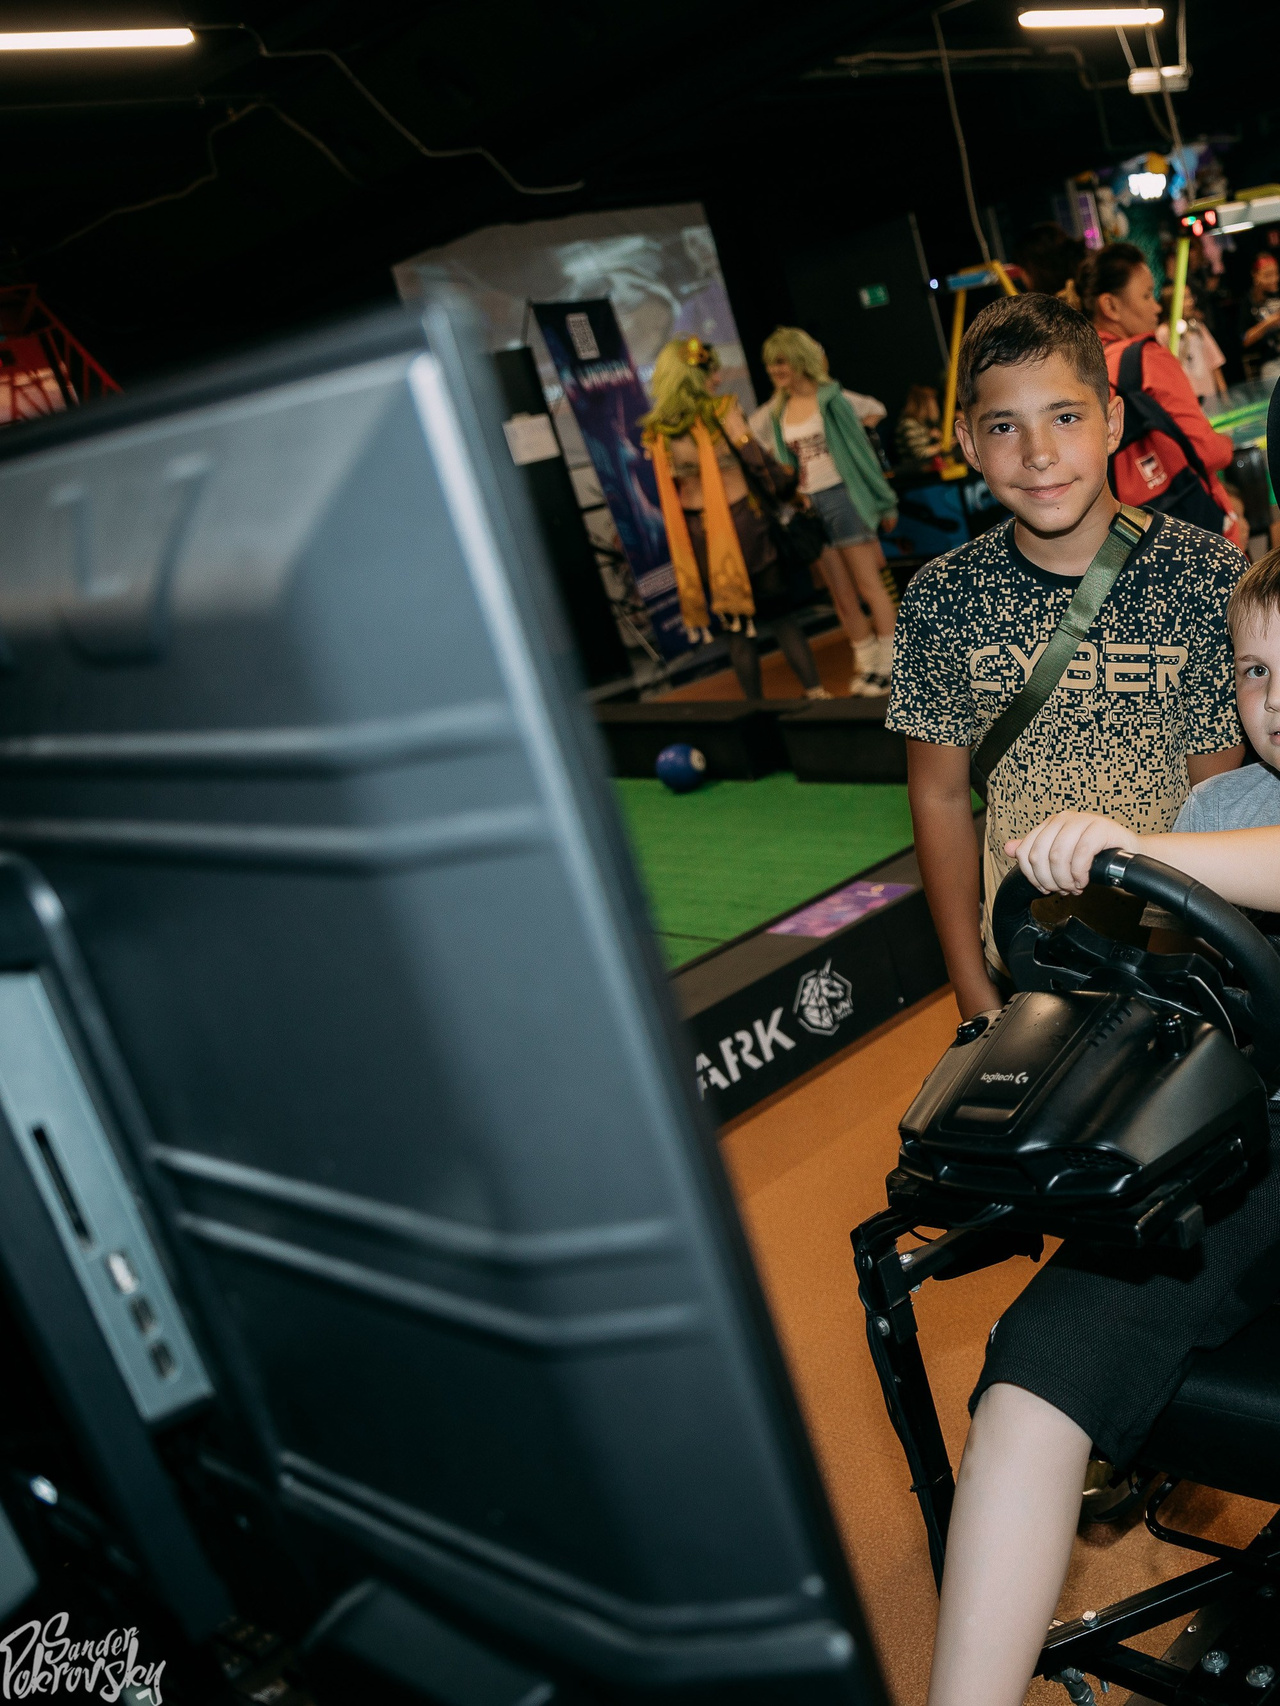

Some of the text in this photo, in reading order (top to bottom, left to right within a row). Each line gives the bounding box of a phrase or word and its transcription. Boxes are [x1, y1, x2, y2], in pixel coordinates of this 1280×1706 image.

[970, 642, 1188, 692] CYBER
[1042, 703, 1162, 725] ORCE
[980, 1072, 1015, 1083] logitech
